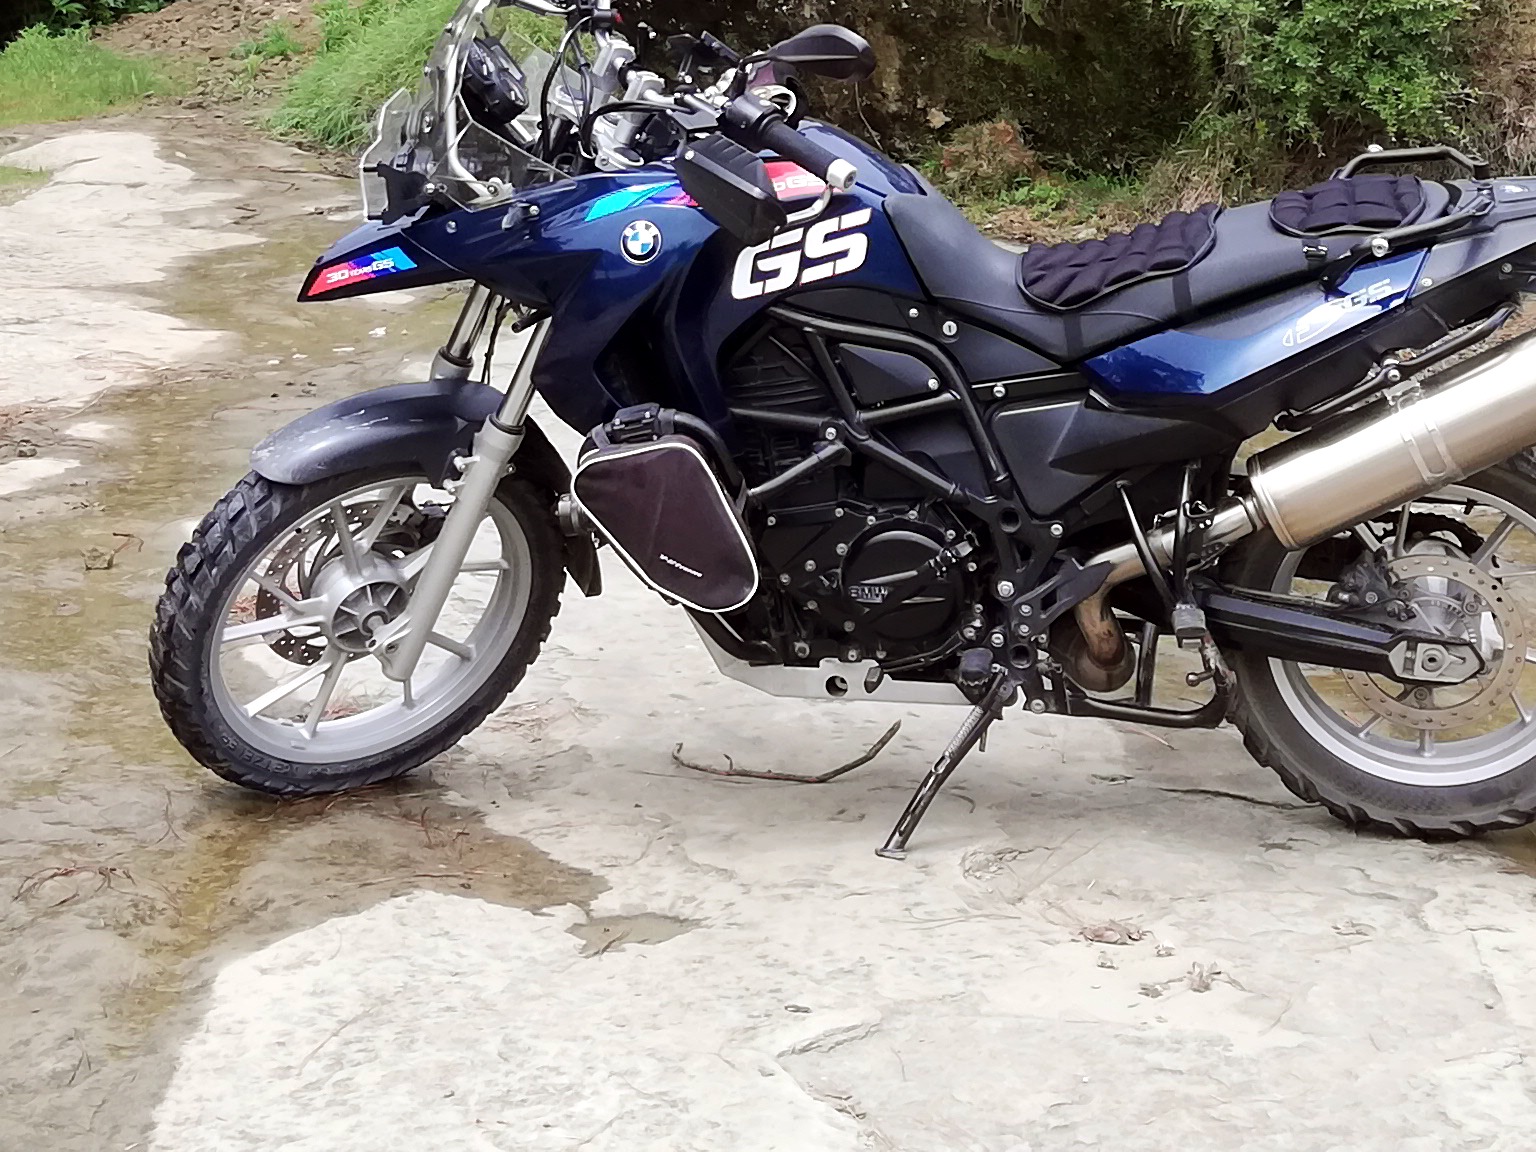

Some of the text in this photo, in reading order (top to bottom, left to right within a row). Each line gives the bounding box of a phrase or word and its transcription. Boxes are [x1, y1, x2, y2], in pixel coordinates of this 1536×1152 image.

[731, 207, 872, 300] GS
[325, 268, 350, 284] 30
[371, 257, 396, 272] GS
[847, 585, 890, 604] BMW
